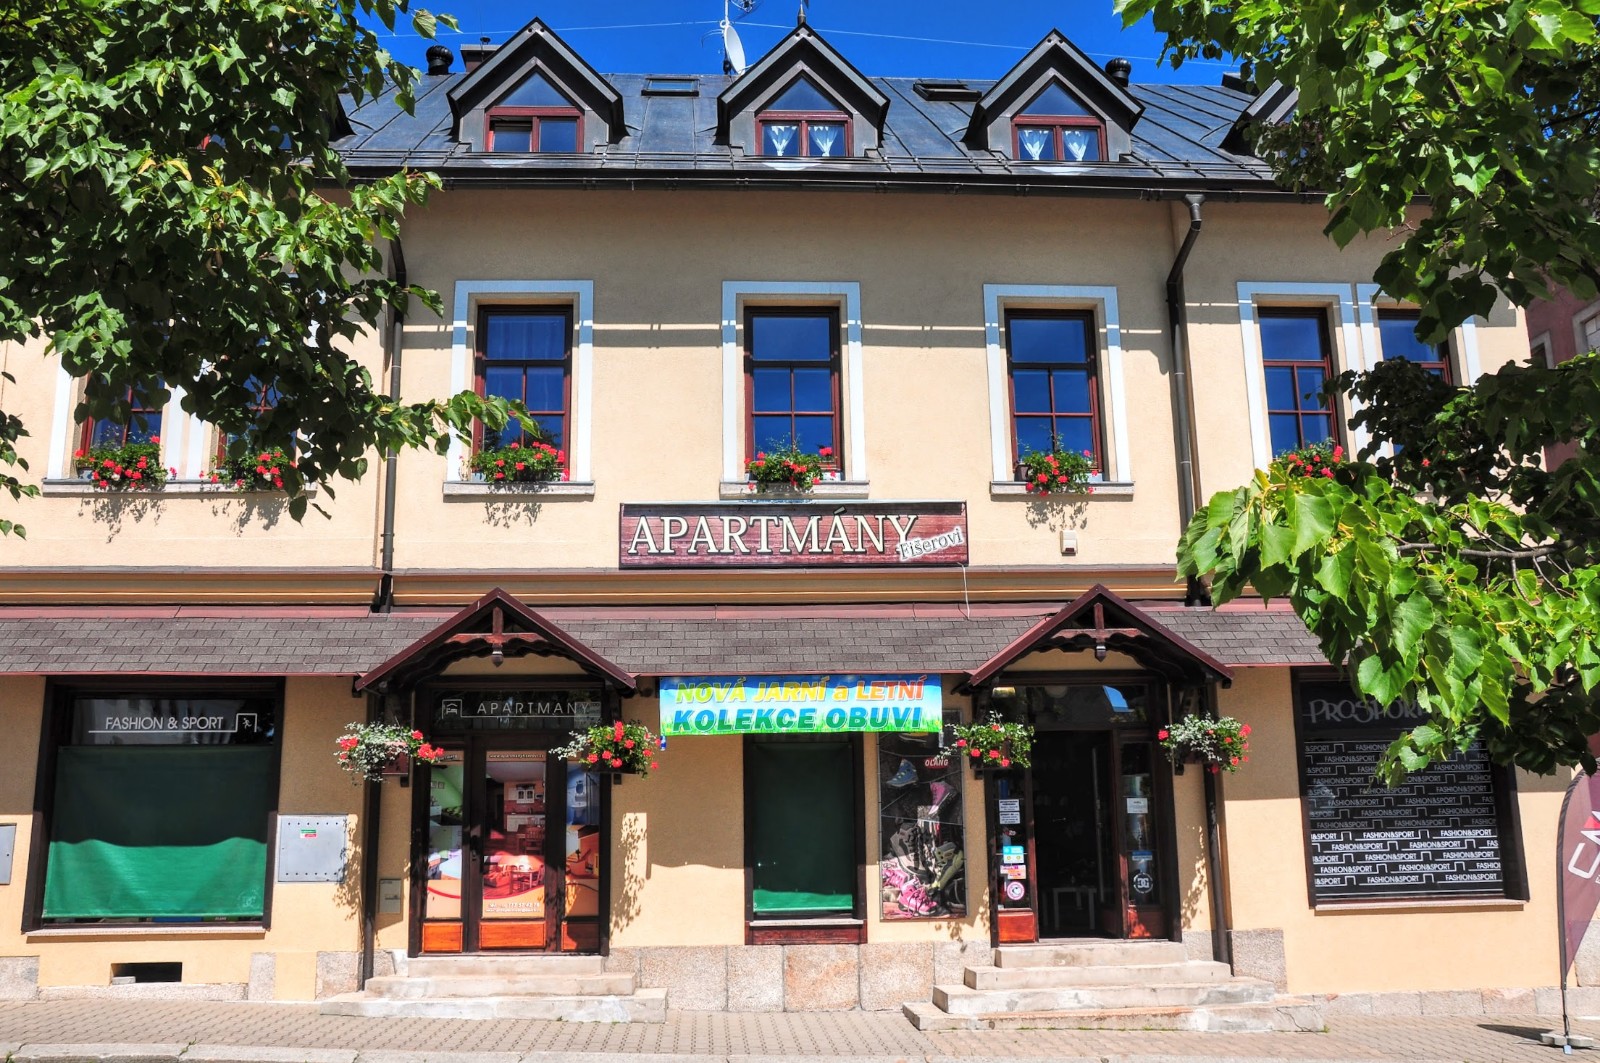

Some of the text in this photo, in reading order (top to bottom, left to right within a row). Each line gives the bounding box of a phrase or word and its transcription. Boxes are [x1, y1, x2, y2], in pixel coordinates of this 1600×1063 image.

[627, 506, 917, 554] APARTMÁNY
[900, 531, 964, 560] Fišerovi
[676, 674, 927, 703] NOVÁ JARNÍ a LETNÍ
[477, 702, 591, 715] APARTMANY
[105, 716, 224, 730] FASHION & SPORT
[672, 706, 921, 733] KOLEKCE OBUVI
[1325, 755, 1376, 763] FASHION&SPORT
[1434, 763, 1485, 771] FASHION&SPORT
[1436, 785, 1487, 793] FASHION&SPORT
[1328, 798, 1379, 807] FASHION&SPORT
[1405, 797, 1456, 805] FASHION&SPORT
[1361, 809, 1412, 817] FASHION&SPORT
[1438, 807, 1489, 815] FASHION&SPORT
[1317, 820, 1368, 829] FASHION&SPORT
[1394, 819, 1446, 827] FASHION&SPORT
[1363, 830, 1414, 839] FASHION&SPORT
[1440, 829, 1492, 837] FASHION&SPORT
[1331, 842, 1383, 851] FASHION&SPORT
[1409, 840, 1461, 849] FASHION&SPORT
[1365, 853, 1417, 861] FASHION&SPORT
[1443, 851, 1494, 859] FASHION&SPORT
[1320, 865, 1372, 874] FASHION&SPORT
[1398, 863, 1450, 871] FASHION&SPORT
[1367, 876, 1419, 884] FASHION&SPORT
[1445, 873, 1497, 881] FASHION&SPORT
